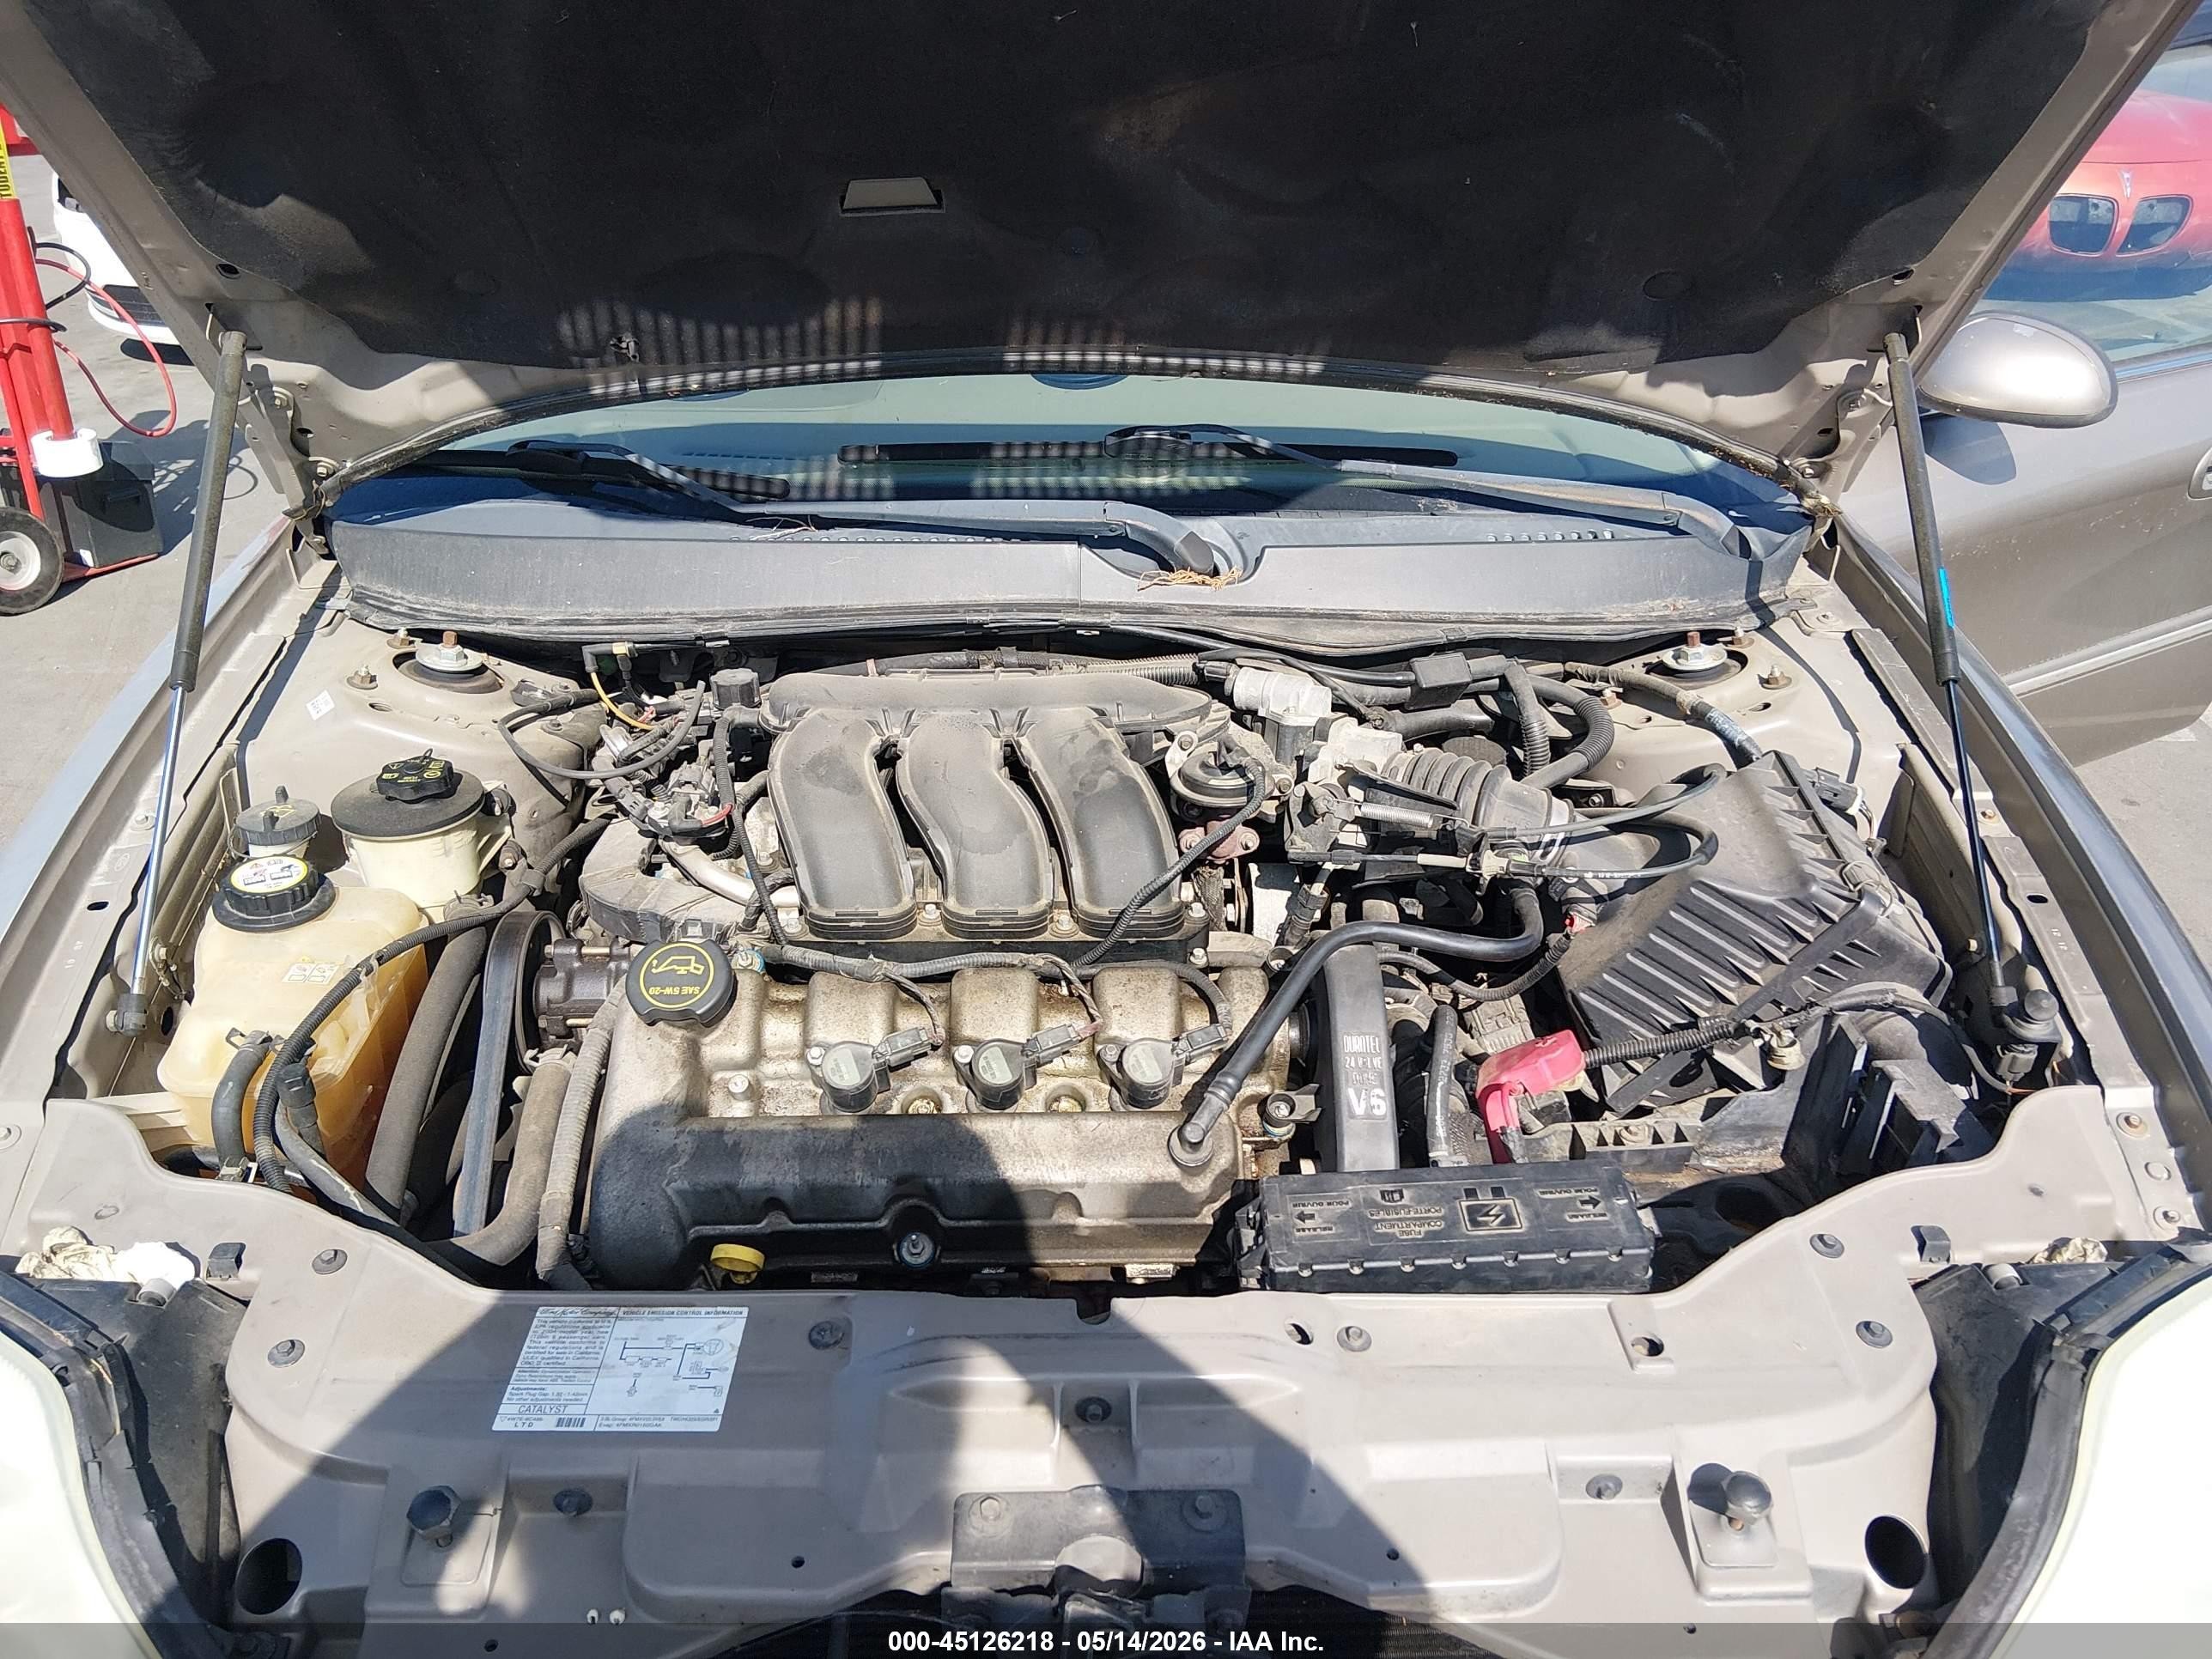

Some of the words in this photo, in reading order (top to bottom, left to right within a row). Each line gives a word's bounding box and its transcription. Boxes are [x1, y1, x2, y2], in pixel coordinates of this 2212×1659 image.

[648, 986, 680, 995] 5W-20
[681, 986, 701, 994] SAE
[1347, 1087, 1388, 1116] V6
[1368, 1207, 1443, 1218] PORTE-FUSIBLES
[1375, 1220, 1443, 1231] COMPARTMENT
[1398, 1229, 1422, 1237] FUSE
[518, 1405, 568, 1413] CATALYST
